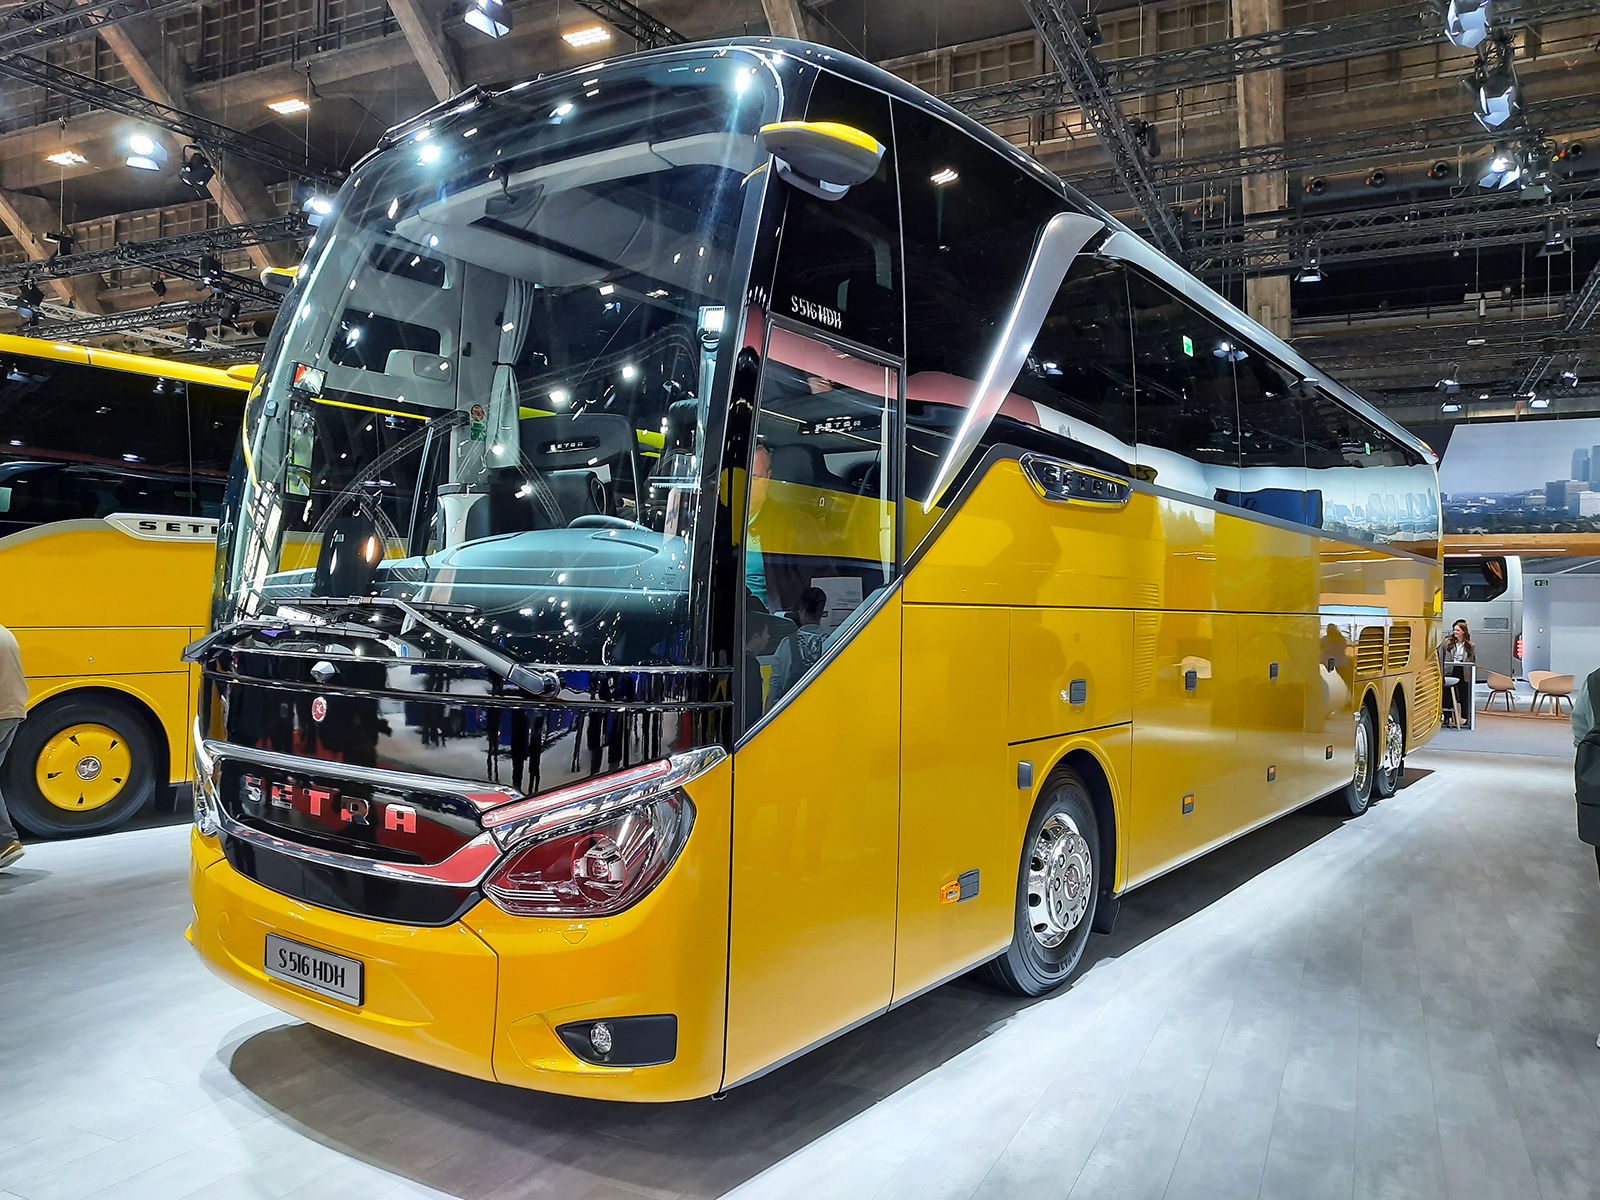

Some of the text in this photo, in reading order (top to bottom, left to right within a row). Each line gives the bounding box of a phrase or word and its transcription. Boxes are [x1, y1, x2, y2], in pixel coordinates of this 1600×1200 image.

[242, 774, 417, 834] SETRA
[278, 948, 288, 969] S
[289, 951, 311, 977] 516
[312, 958, 345, 988] HDH
